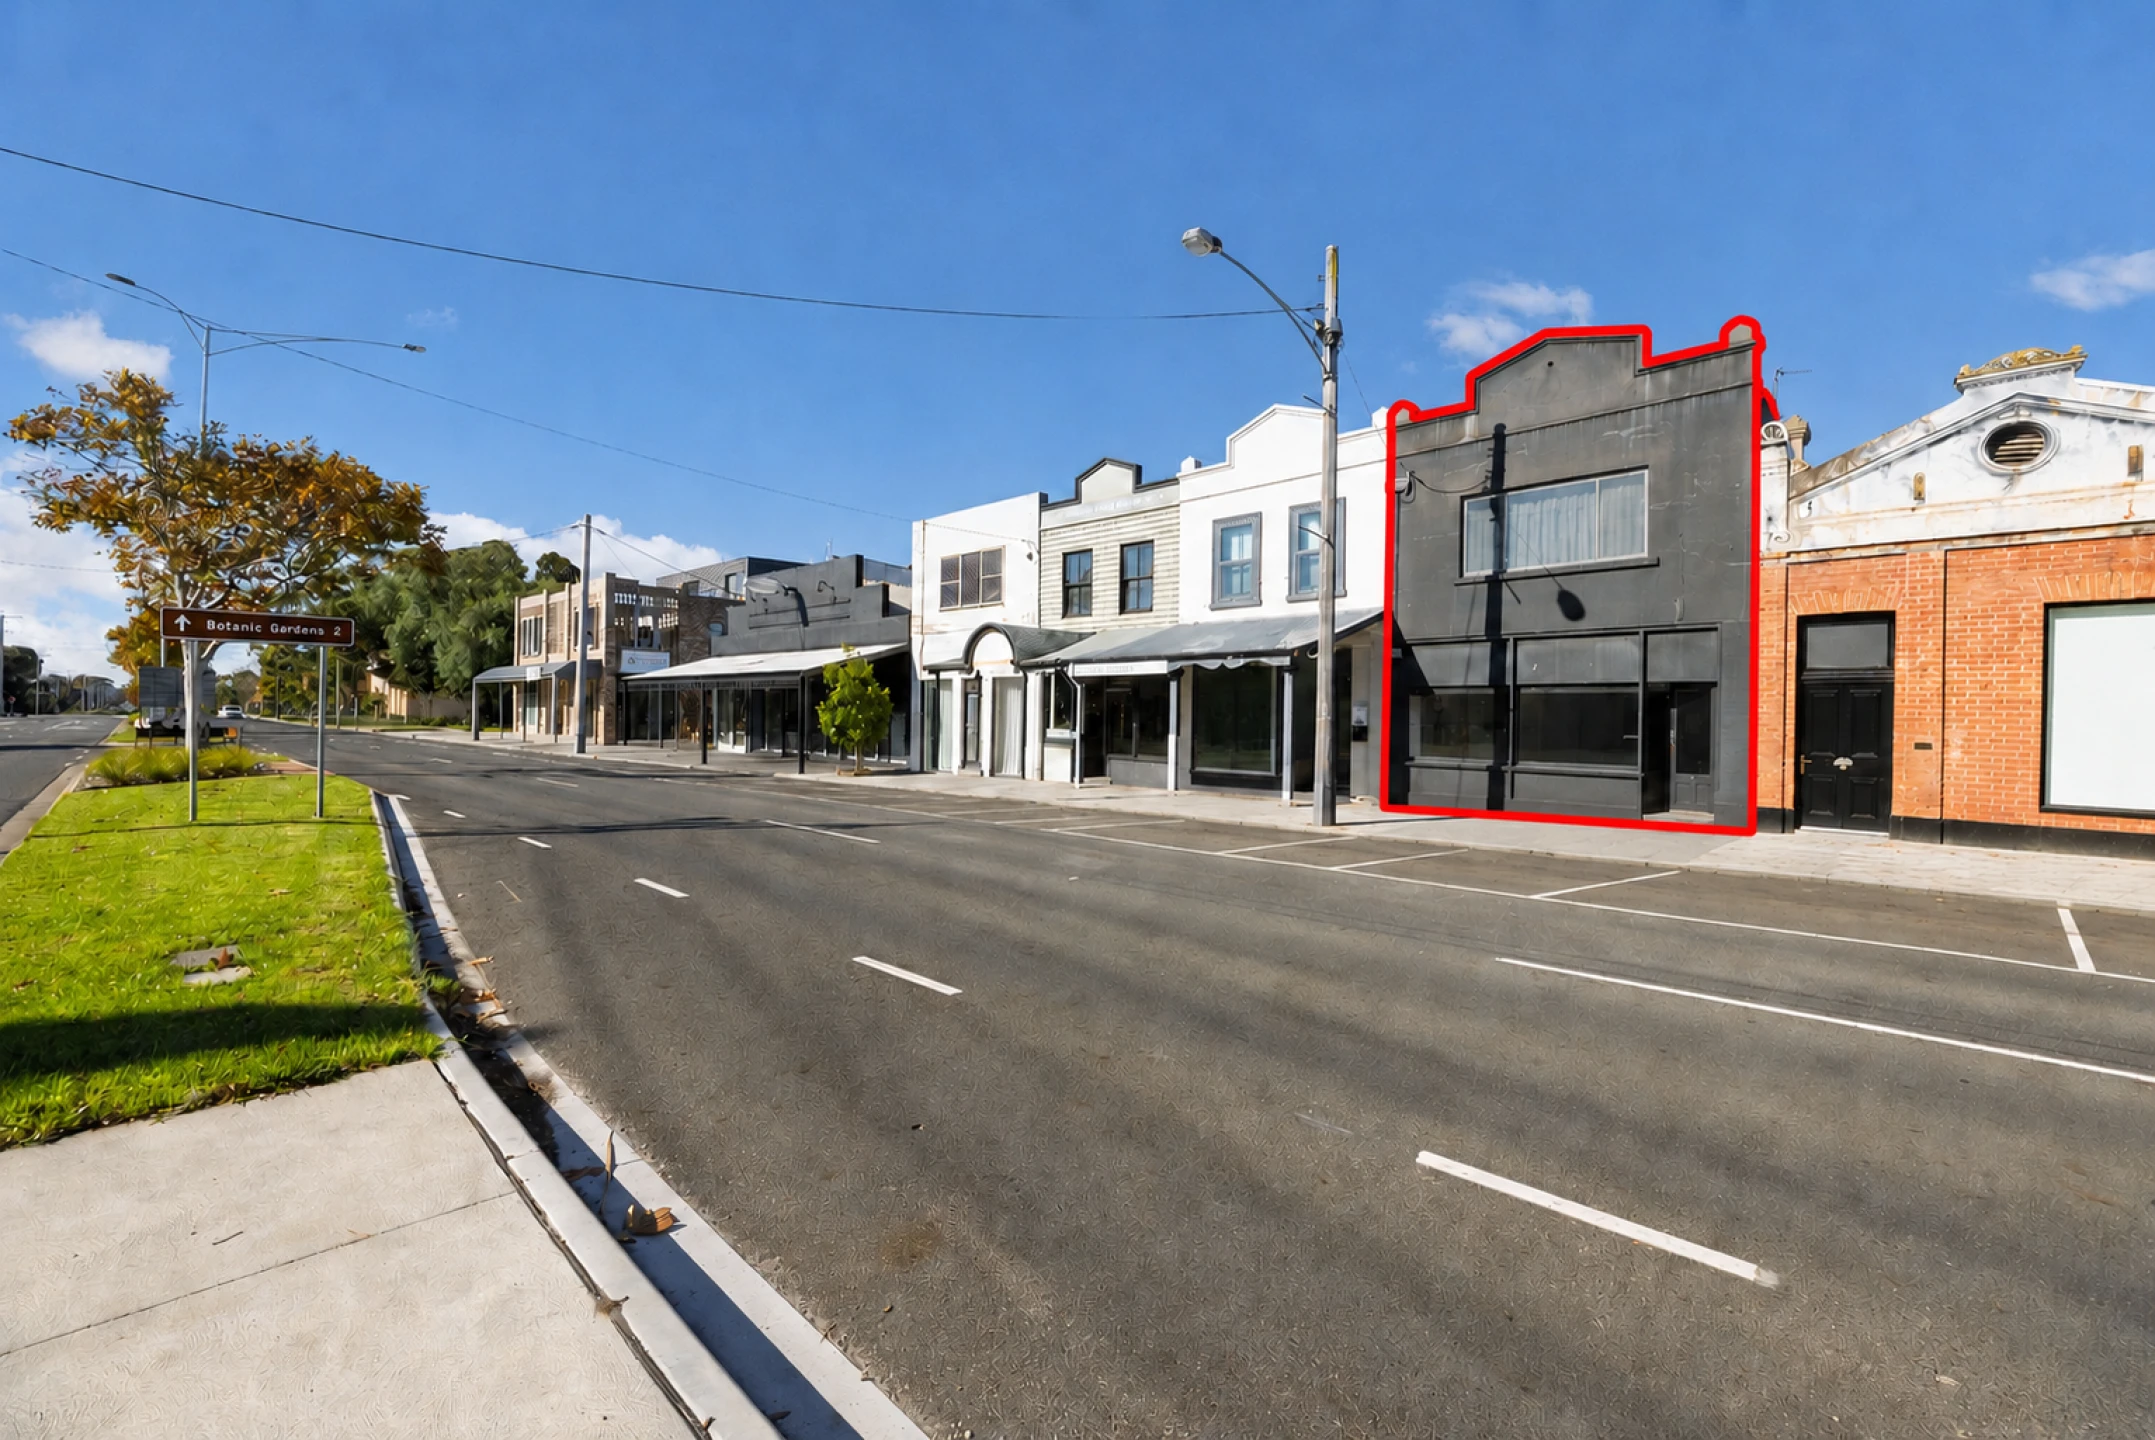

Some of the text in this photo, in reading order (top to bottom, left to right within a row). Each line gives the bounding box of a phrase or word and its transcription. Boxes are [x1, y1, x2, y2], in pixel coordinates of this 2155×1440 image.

[206, 619, 341, 637] Botanic Gardens 2
